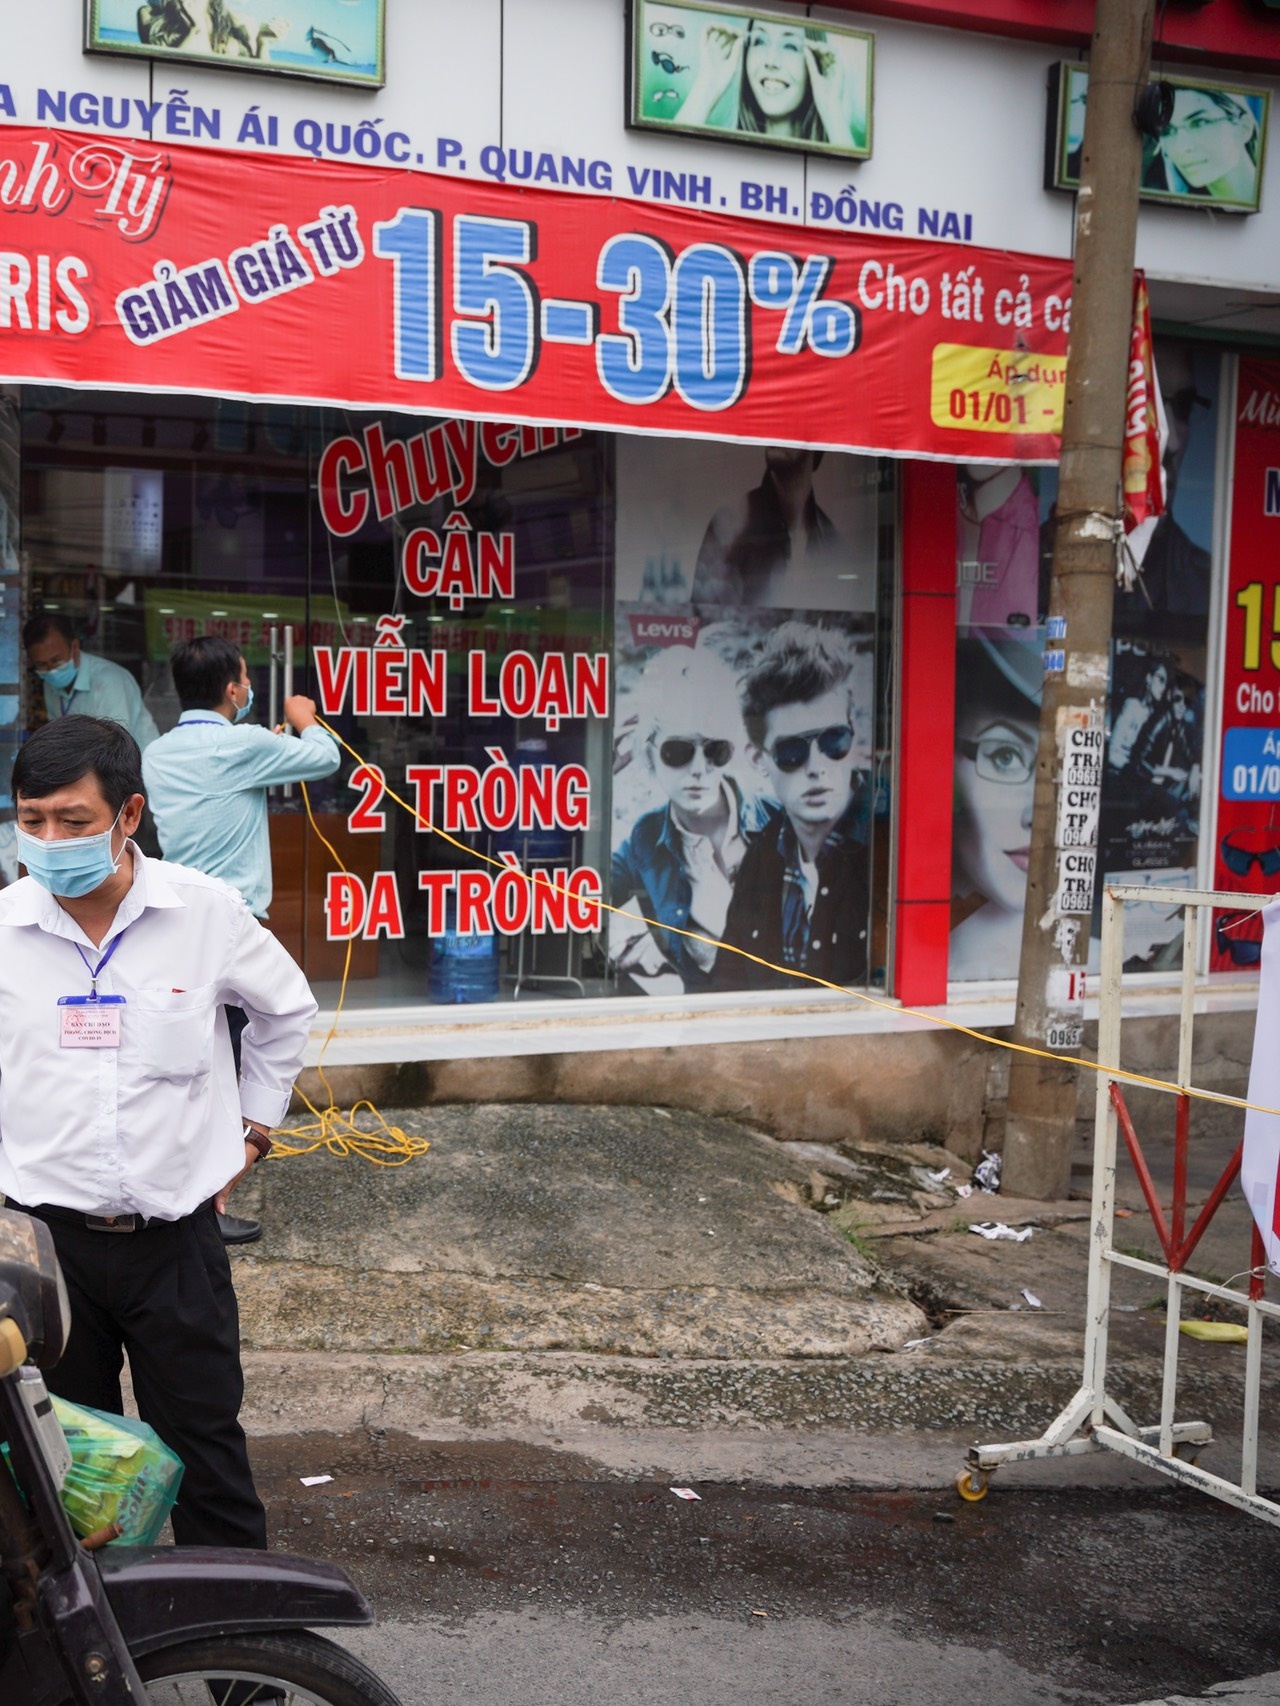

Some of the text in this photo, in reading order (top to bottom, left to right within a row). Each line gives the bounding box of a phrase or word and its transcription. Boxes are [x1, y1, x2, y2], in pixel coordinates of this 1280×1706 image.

[36, 87, 221, 140] NGUYỄN
[238, 105, 279, 147] ÁI
[436, 138, 467, 170] P.
[480, 145, 613, 191] QUANG
[740, 181, 800, 216] BH.
[811, 184, 904, 232] ĐỒNG
[918, 209, 973, 241] NAI
[68, 142, 171, 237] Tý
[118, 207, 362, 345] GIẢM GIÁ TỪ
[858, 260, 930, 315] Cho
[940, 265, 984, 322] tất
[995, 274, 1032, 328] cả
[949, 388, 1027, 425] 01/01
[318, 419, 565, 538] Chuy
[403, 511, 515, 610] CẬN
[314, 614, 609, 732] VIỄN LOẠN
[1236, 682, 1274, 714] Cho
[348, 746, 590, 833] 2 TRÒNG
[325, 851, 602, 941] ĐA TRÒNG
